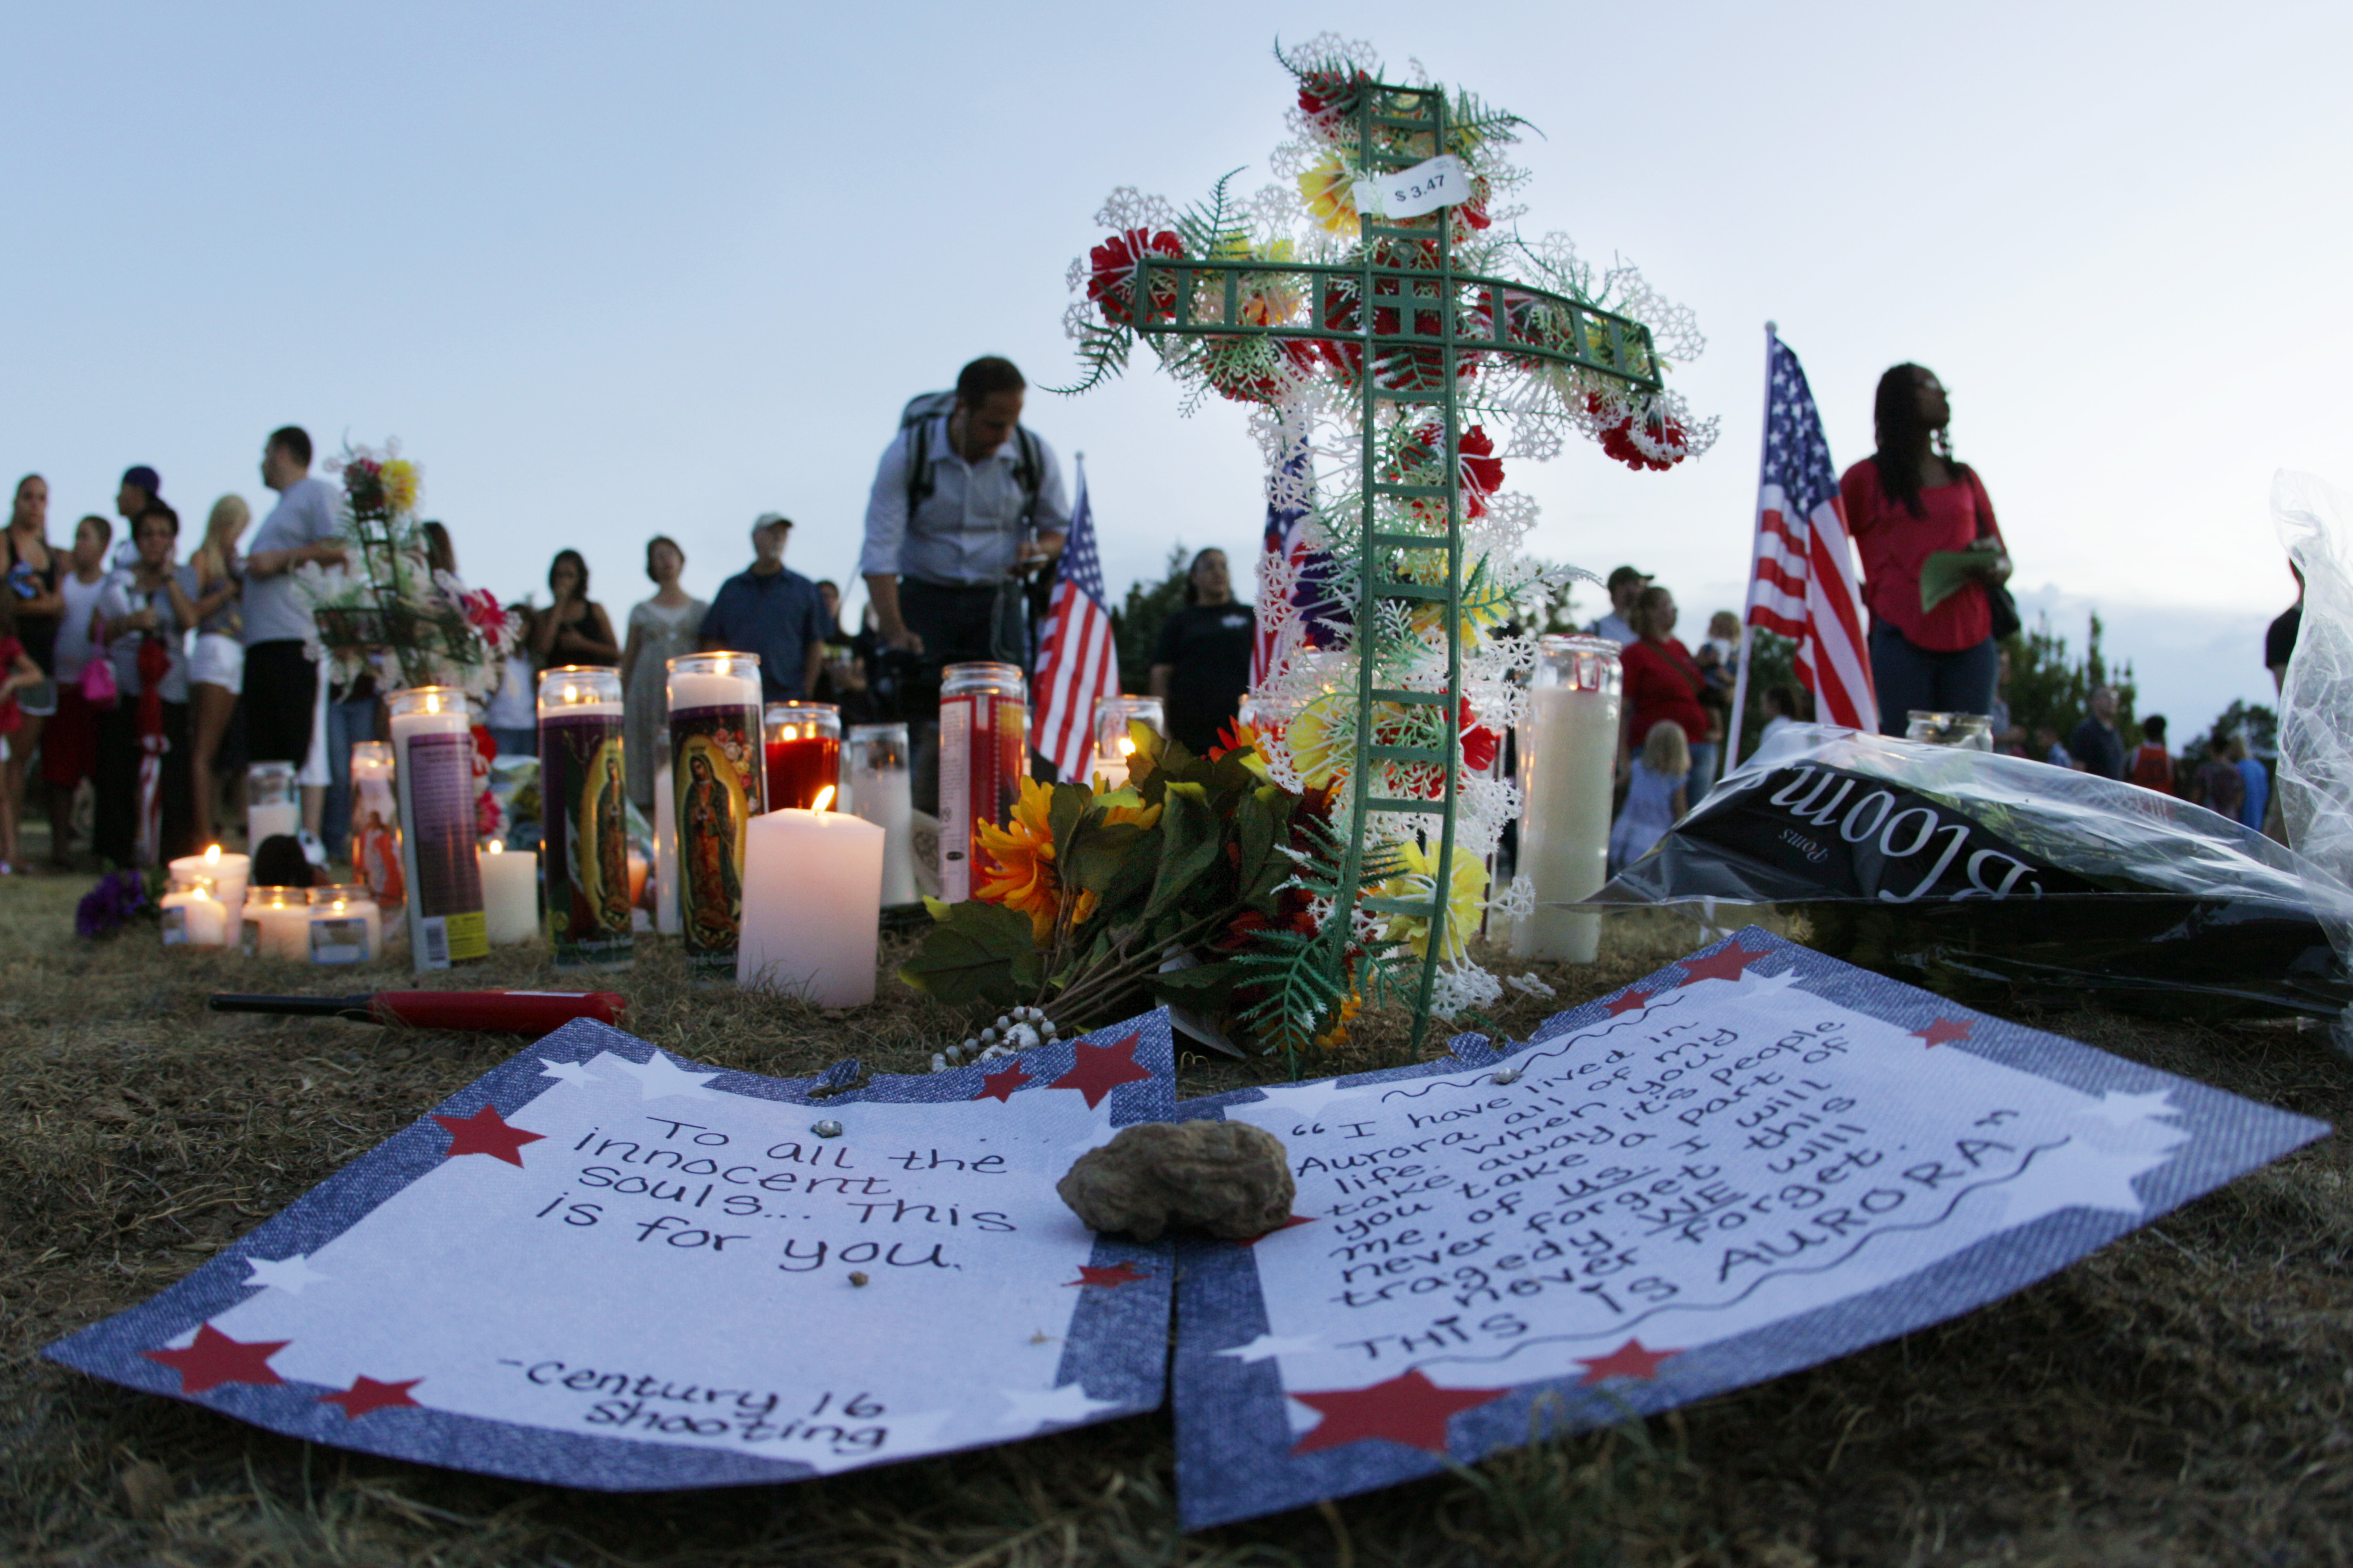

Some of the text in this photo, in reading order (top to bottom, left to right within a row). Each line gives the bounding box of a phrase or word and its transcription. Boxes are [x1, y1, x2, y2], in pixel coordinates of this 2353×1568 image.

[1778, 828, 1829, 863] Poms
[1297, 1028, 1739, 1177] Aurora all of my
[1408, 1096, 1512, 1128] have
[1525, 1049, 1634, 1093] lived
[1644, 1022, 1699, 1043] in
[645, 1116, 1008, 1174] To all the
[1324, 1174, 1454, 1216] take
[1478, 1125, 1615, 1171] away
[1710, 1020, 1845, 1086] people
[1334, 1036, 1850, 1241] you take a part of
[1335, 1165, 1442, 1194] life.
[1627, 1053, 1724, 1095] you
[1468, 1191, 1523, 1224] of
[1668, 1134, 1710, 1156] I
[1736, 1079, 1832, 1128] will
[1766, 1123, 1866, 1174] will
[845, 1200, 1017, 1233] This
[1341, 1096, 1857, 1283] never forget this
[535, 1192, 963, 1272] is for you.
[1334, 1312, 1530, 1359] THIS
[1578, 1275, 1680, 1314] IS
[1452, 1246, 1638, 1308] never
[811, 1391, 887, 1419] 16
